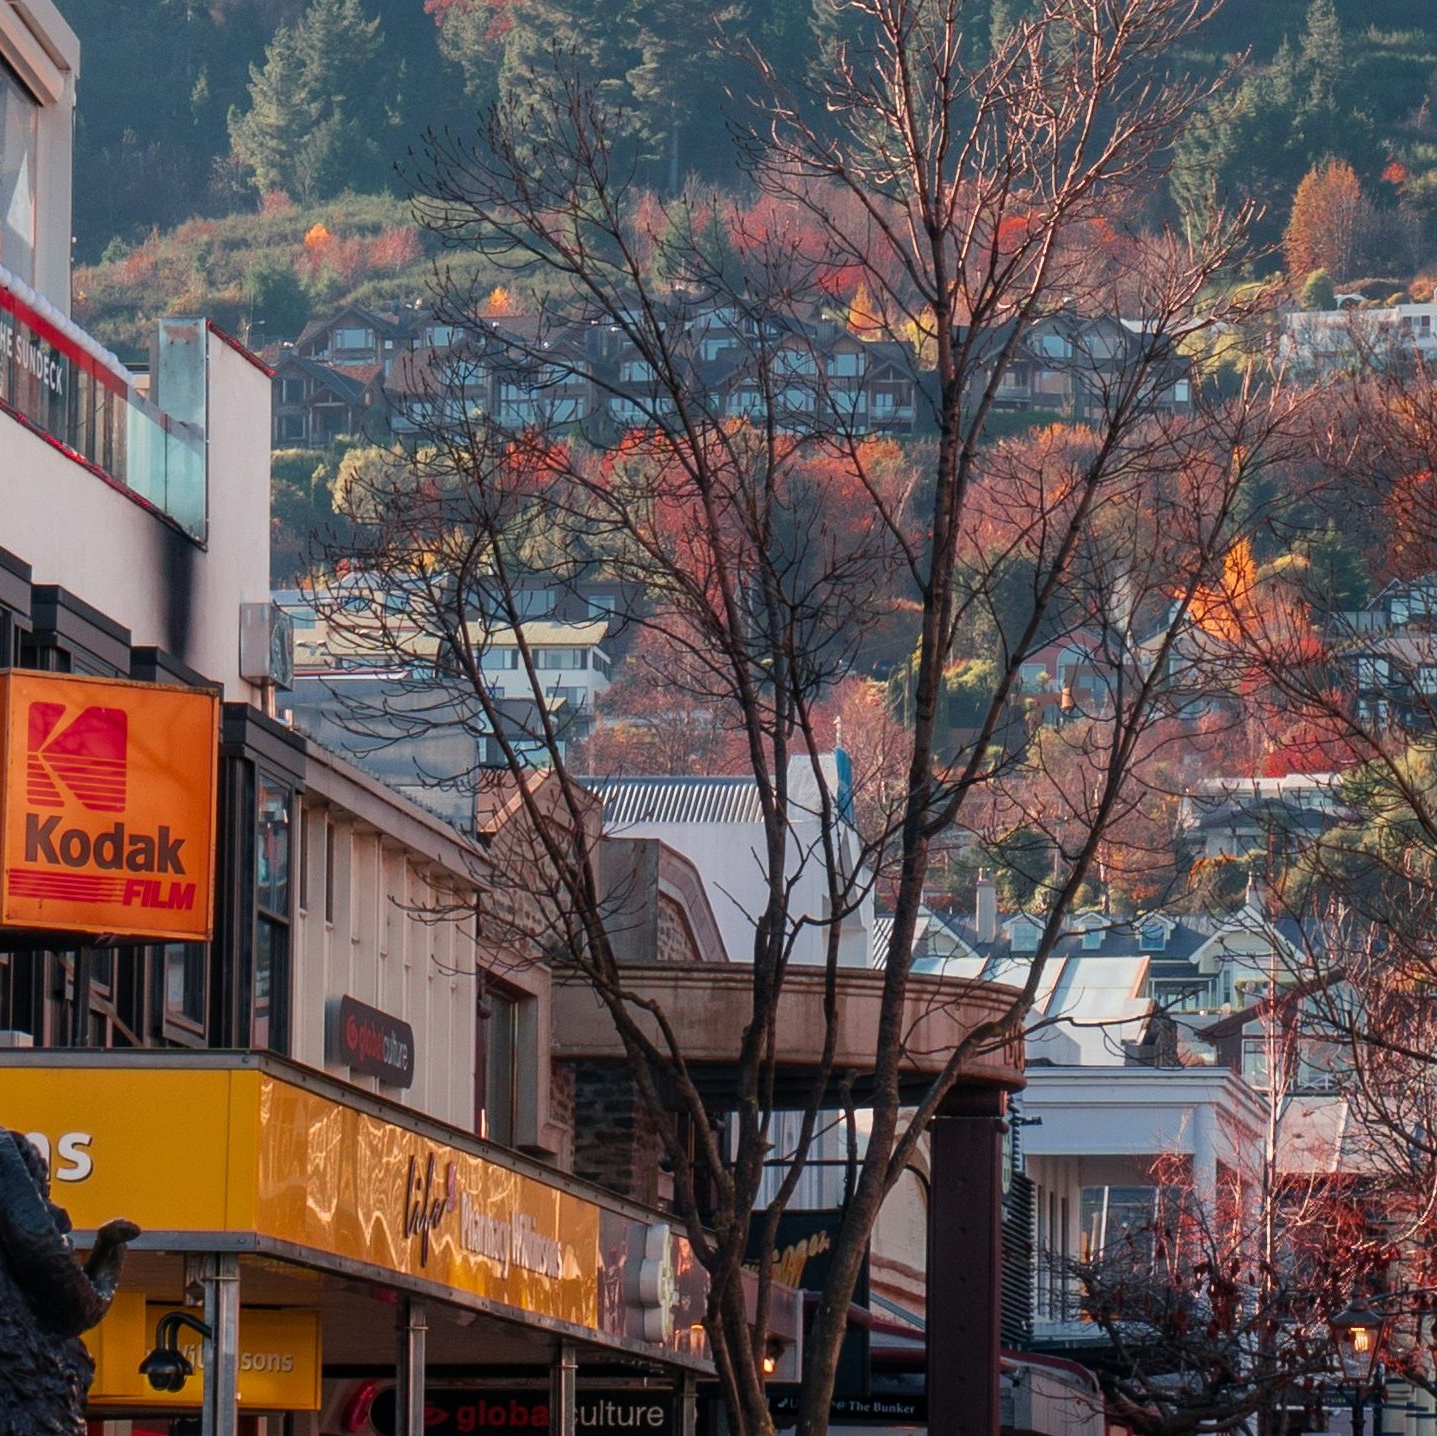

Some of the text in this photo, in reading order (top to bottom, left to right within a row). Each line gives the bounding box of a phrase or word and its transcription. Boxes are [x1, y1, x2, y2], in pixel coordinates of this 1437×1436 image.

[16, 335, 63, 396] SUNDECK
[25, 813, 186, 876] Kodak
[123, 879, 197, 911] FILM
[848, 1401, 870, 1413] The
[873, 1402, 916, 1415] Bunker
